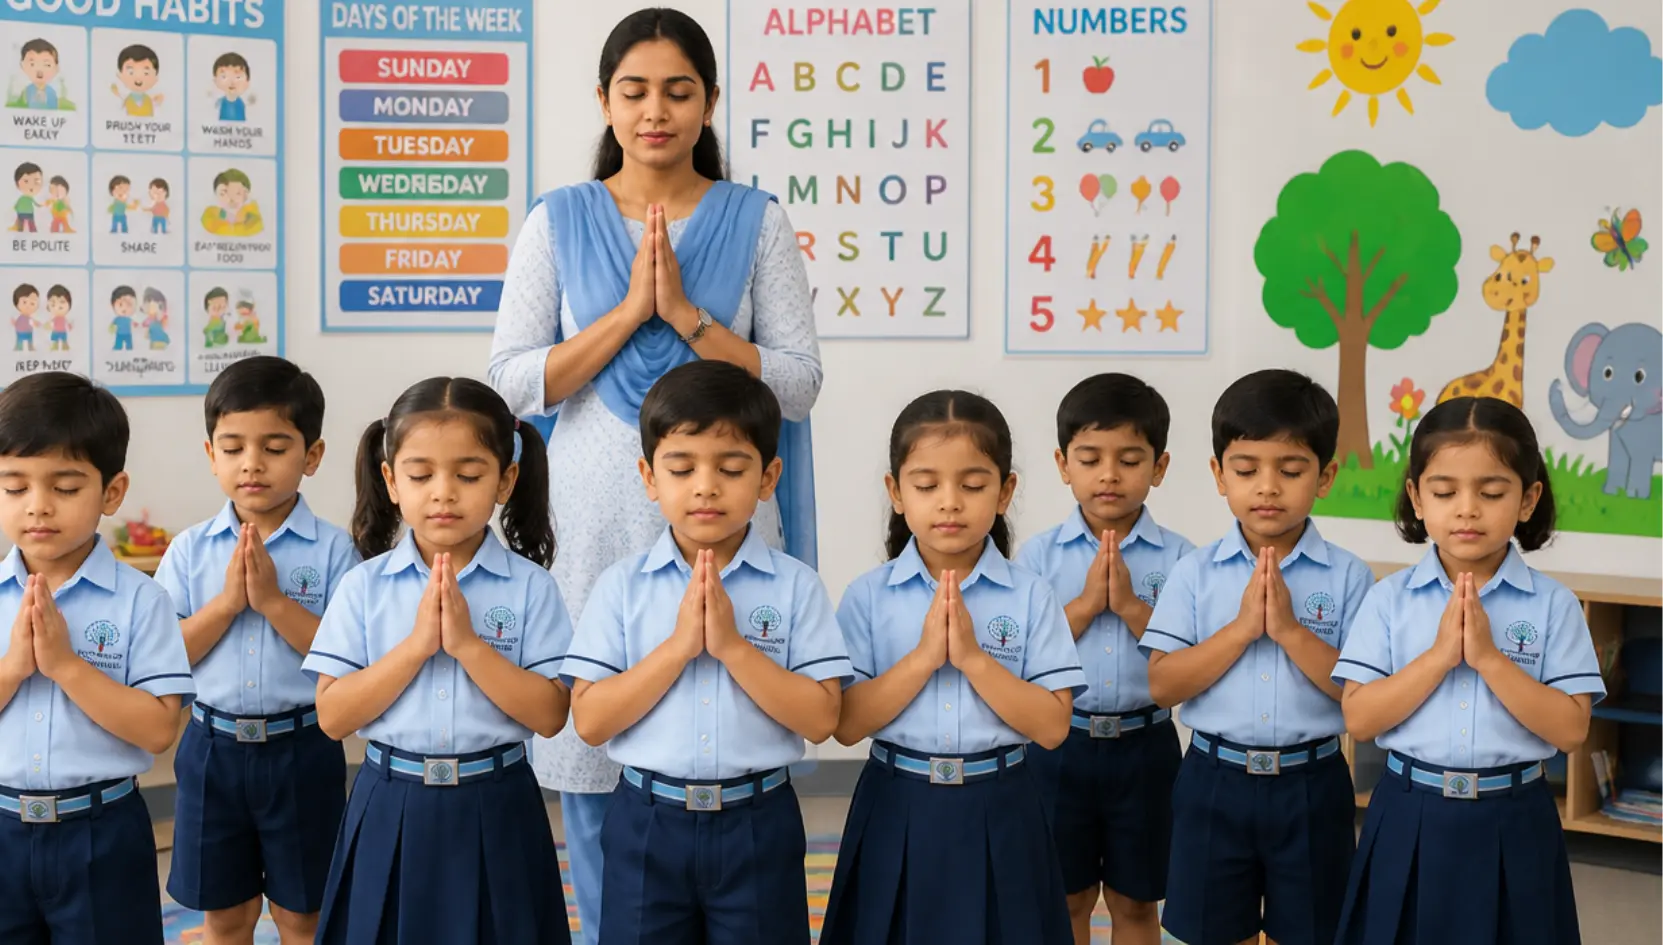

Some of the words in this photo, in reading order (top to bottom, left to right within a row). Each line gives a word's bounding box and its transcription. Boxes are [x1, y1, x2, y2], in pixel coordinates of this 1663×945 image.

[135, 0, 265, 29] HABITS
[332, 2, 388, 30] DAYS
[392, 5, 419, 31] OF
[422, 5, 462, 32] THE
[465, 7, 523, 33] WEEK
[763, 8, 937, 35] ALPHABET
[1033, 6, 1188, 35] NUMBERS
[377, 57, 472, 79] SUNDAY
[749, 61, 775, 92] A
[793, 61, 816, 92] B
[836, 61, 861, 93] C
[880, 61, 906, 92] D
[926, 61, 947, 92] E
[1034, 58, 1051, 94] 1
[12, 115, 47, 127] WAKE
[373, 96, 474, 117] MONDAY
[373, 135, 475, 156] TUESDAY
[751, 118, 771, 149] F
[787, 118, 813, 149] G
[827, 118, 852, 149] H
[868, 119, 876, 149] I
[891, 118, 909, 149] J
[925, 118, 949, 149] K
[1032, 117, 1056, 154] 2
[787, 175, 818, 205] M
[836, 175, 861, 205] N
[878, 174, 907, 205] O
[925, 174, 947, 205] P
[1030, 175, 1056, 212] 3
[366, 211, 481, 232] THURSDAY
[12, 239, 27, 252] BE
[31, 240, 71, 252] POLITE
[120, 241, 157, 254] SHARE
[385, 248, 463, 269] FRIDAY
[837, 231, 860, 262] S
[880, 231, 904, 262] T
[923, 231, 948, 262] U
[1028, 235, 1057, 272] 4
[368, 285, 483, 306] SATURDAY
[836, 286, 861, 317] X
[880, 286, 904, 318] Y
[922, 286, 946, 317] Z
[1029, 295, 1055, 333] 5
